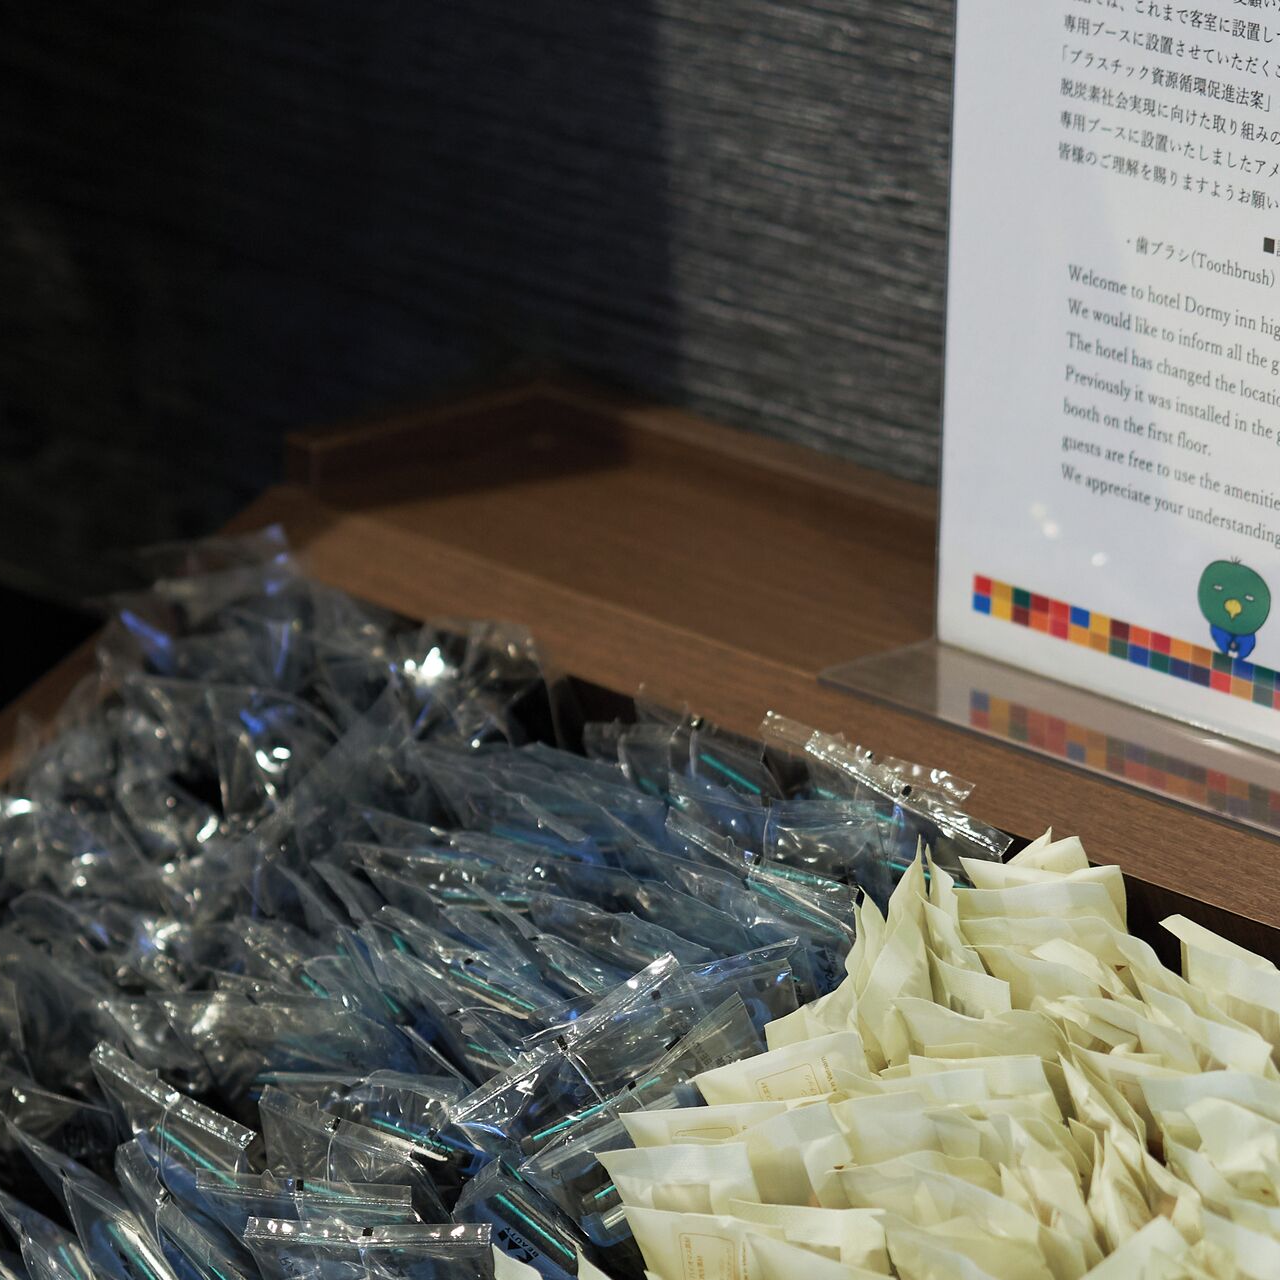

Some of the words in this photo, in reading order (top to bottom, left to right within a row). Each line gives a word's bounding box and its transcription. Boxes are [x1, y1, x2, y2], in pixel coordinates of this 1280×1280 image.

[1067, 262, 1128, 295] Welcome
[1130, 284, 1144, 300] to
[1146, 283, 1181, 310] hotel
[1183, 294, 1231, 327] Dormy
[1233, 308, 1256, 331] inn
[1065, 330, 1092, 353] The
[1094, 337, 1128, 364] hotel
[1130, 347, 1153, 371] has
[1155, 356, 1211, 388] changed
[1214, 373, 1237, 394] the
[1067, 296, 1089, 319] We
[1091, 309, 1131, 331] would
[1134, 315, 1158, 338] like
[1160, 326, 1175, 343] to
[1177, 327, 1223, 356] inform
[1225, 342, 1243, 362] all
[1245, 346, 1268, 369] the
[1062, 396, 1100, 424] booth
[1102, 413, 1120, 429] on
[1122, 414, 1145, 436] the
[1146, 421, 1173, 445] first
[1176, 430, 1211, 457] floor.
[1064, 363, 1131, 402] Previously
[1133, 383, 1144, 403] it
[1146, 393, 1172, 411] was
[1174, 395, 1231, 428] installed
[1233, 412, 1247, 432] in
[1250, 417, 1273, 439] the
[1060, 435, 1101, 457] guests
[1103, 448, 1125, 464] are
[1127, 449, 1153, 473] free
[1156, 462, 1170, 478] to
[1173, 468, 1196, 485] use
[1198, 471, 1221, 493] the
[1060, 462, 1082, 483] We
[1084, 475, 1152, 506] appreciate
[1153, 496, 1184, 516] your
[504, 1226, 540, 1258] BEAUTY
